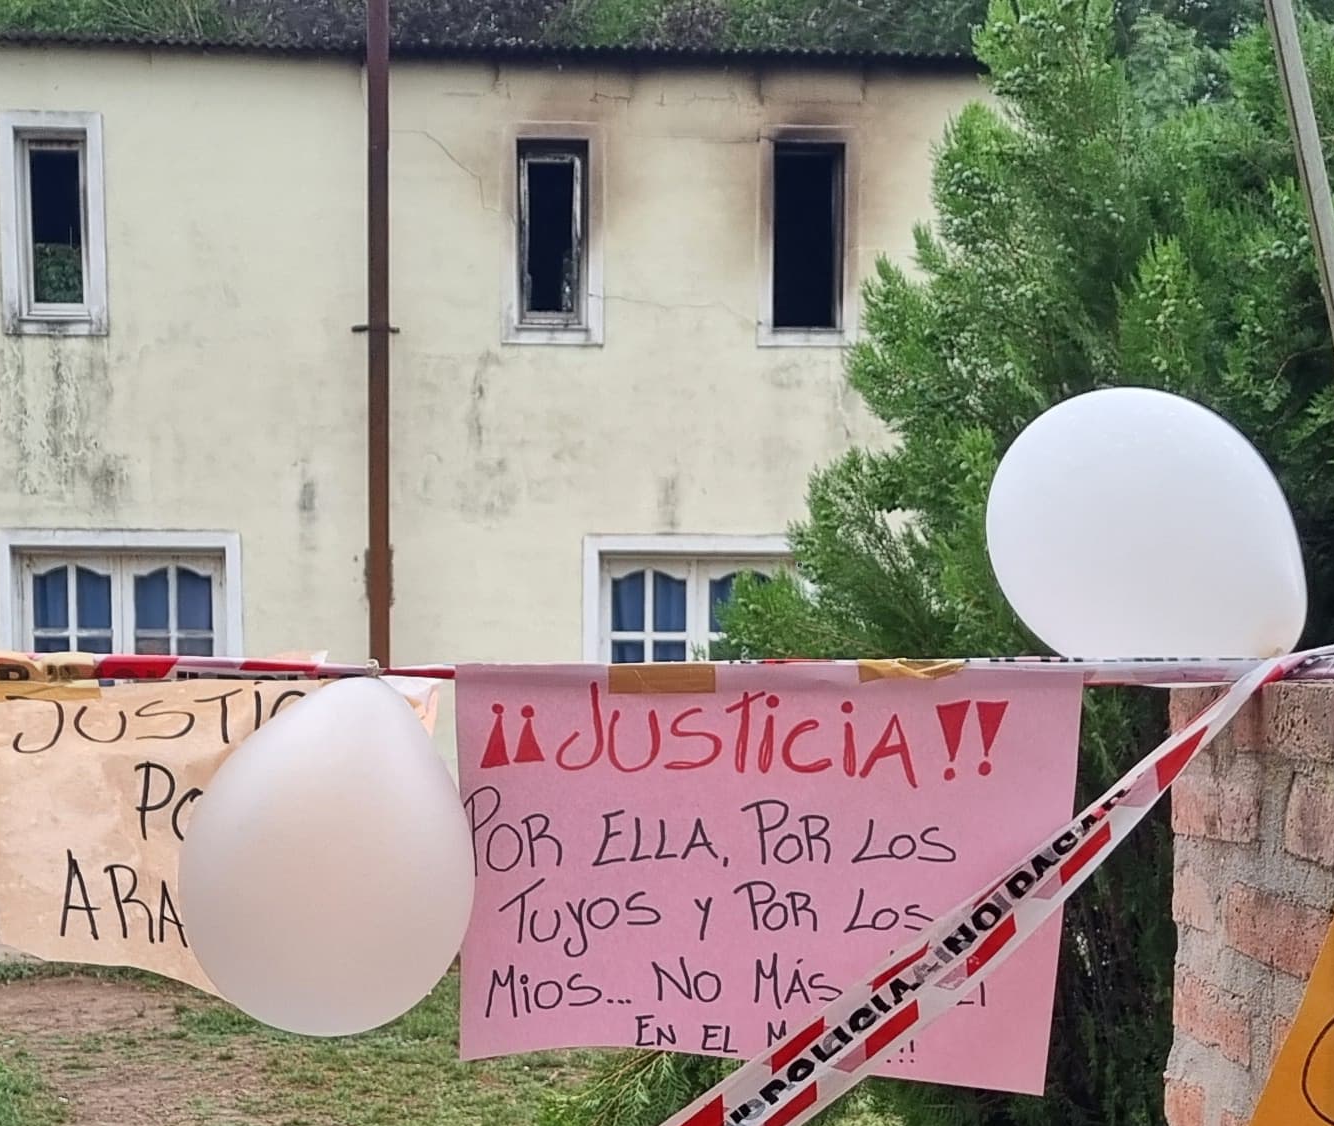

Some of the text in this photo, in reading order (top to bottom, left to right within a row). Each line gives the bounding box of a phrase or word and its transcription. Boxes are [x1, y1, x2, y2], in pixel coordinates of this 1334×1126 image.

[463, 785, 563, 878] POR
[741, 799, 833, 865] POR
[851, 818, 958, 864] LOS
[733, 880, 818, 933] POR
[651, 956, 722, 1004] NO
[754, 952, 844, 1009] MÁS
[635, 1014, 677, 1047] EN
[702, 1024, 739, 1054] EL
